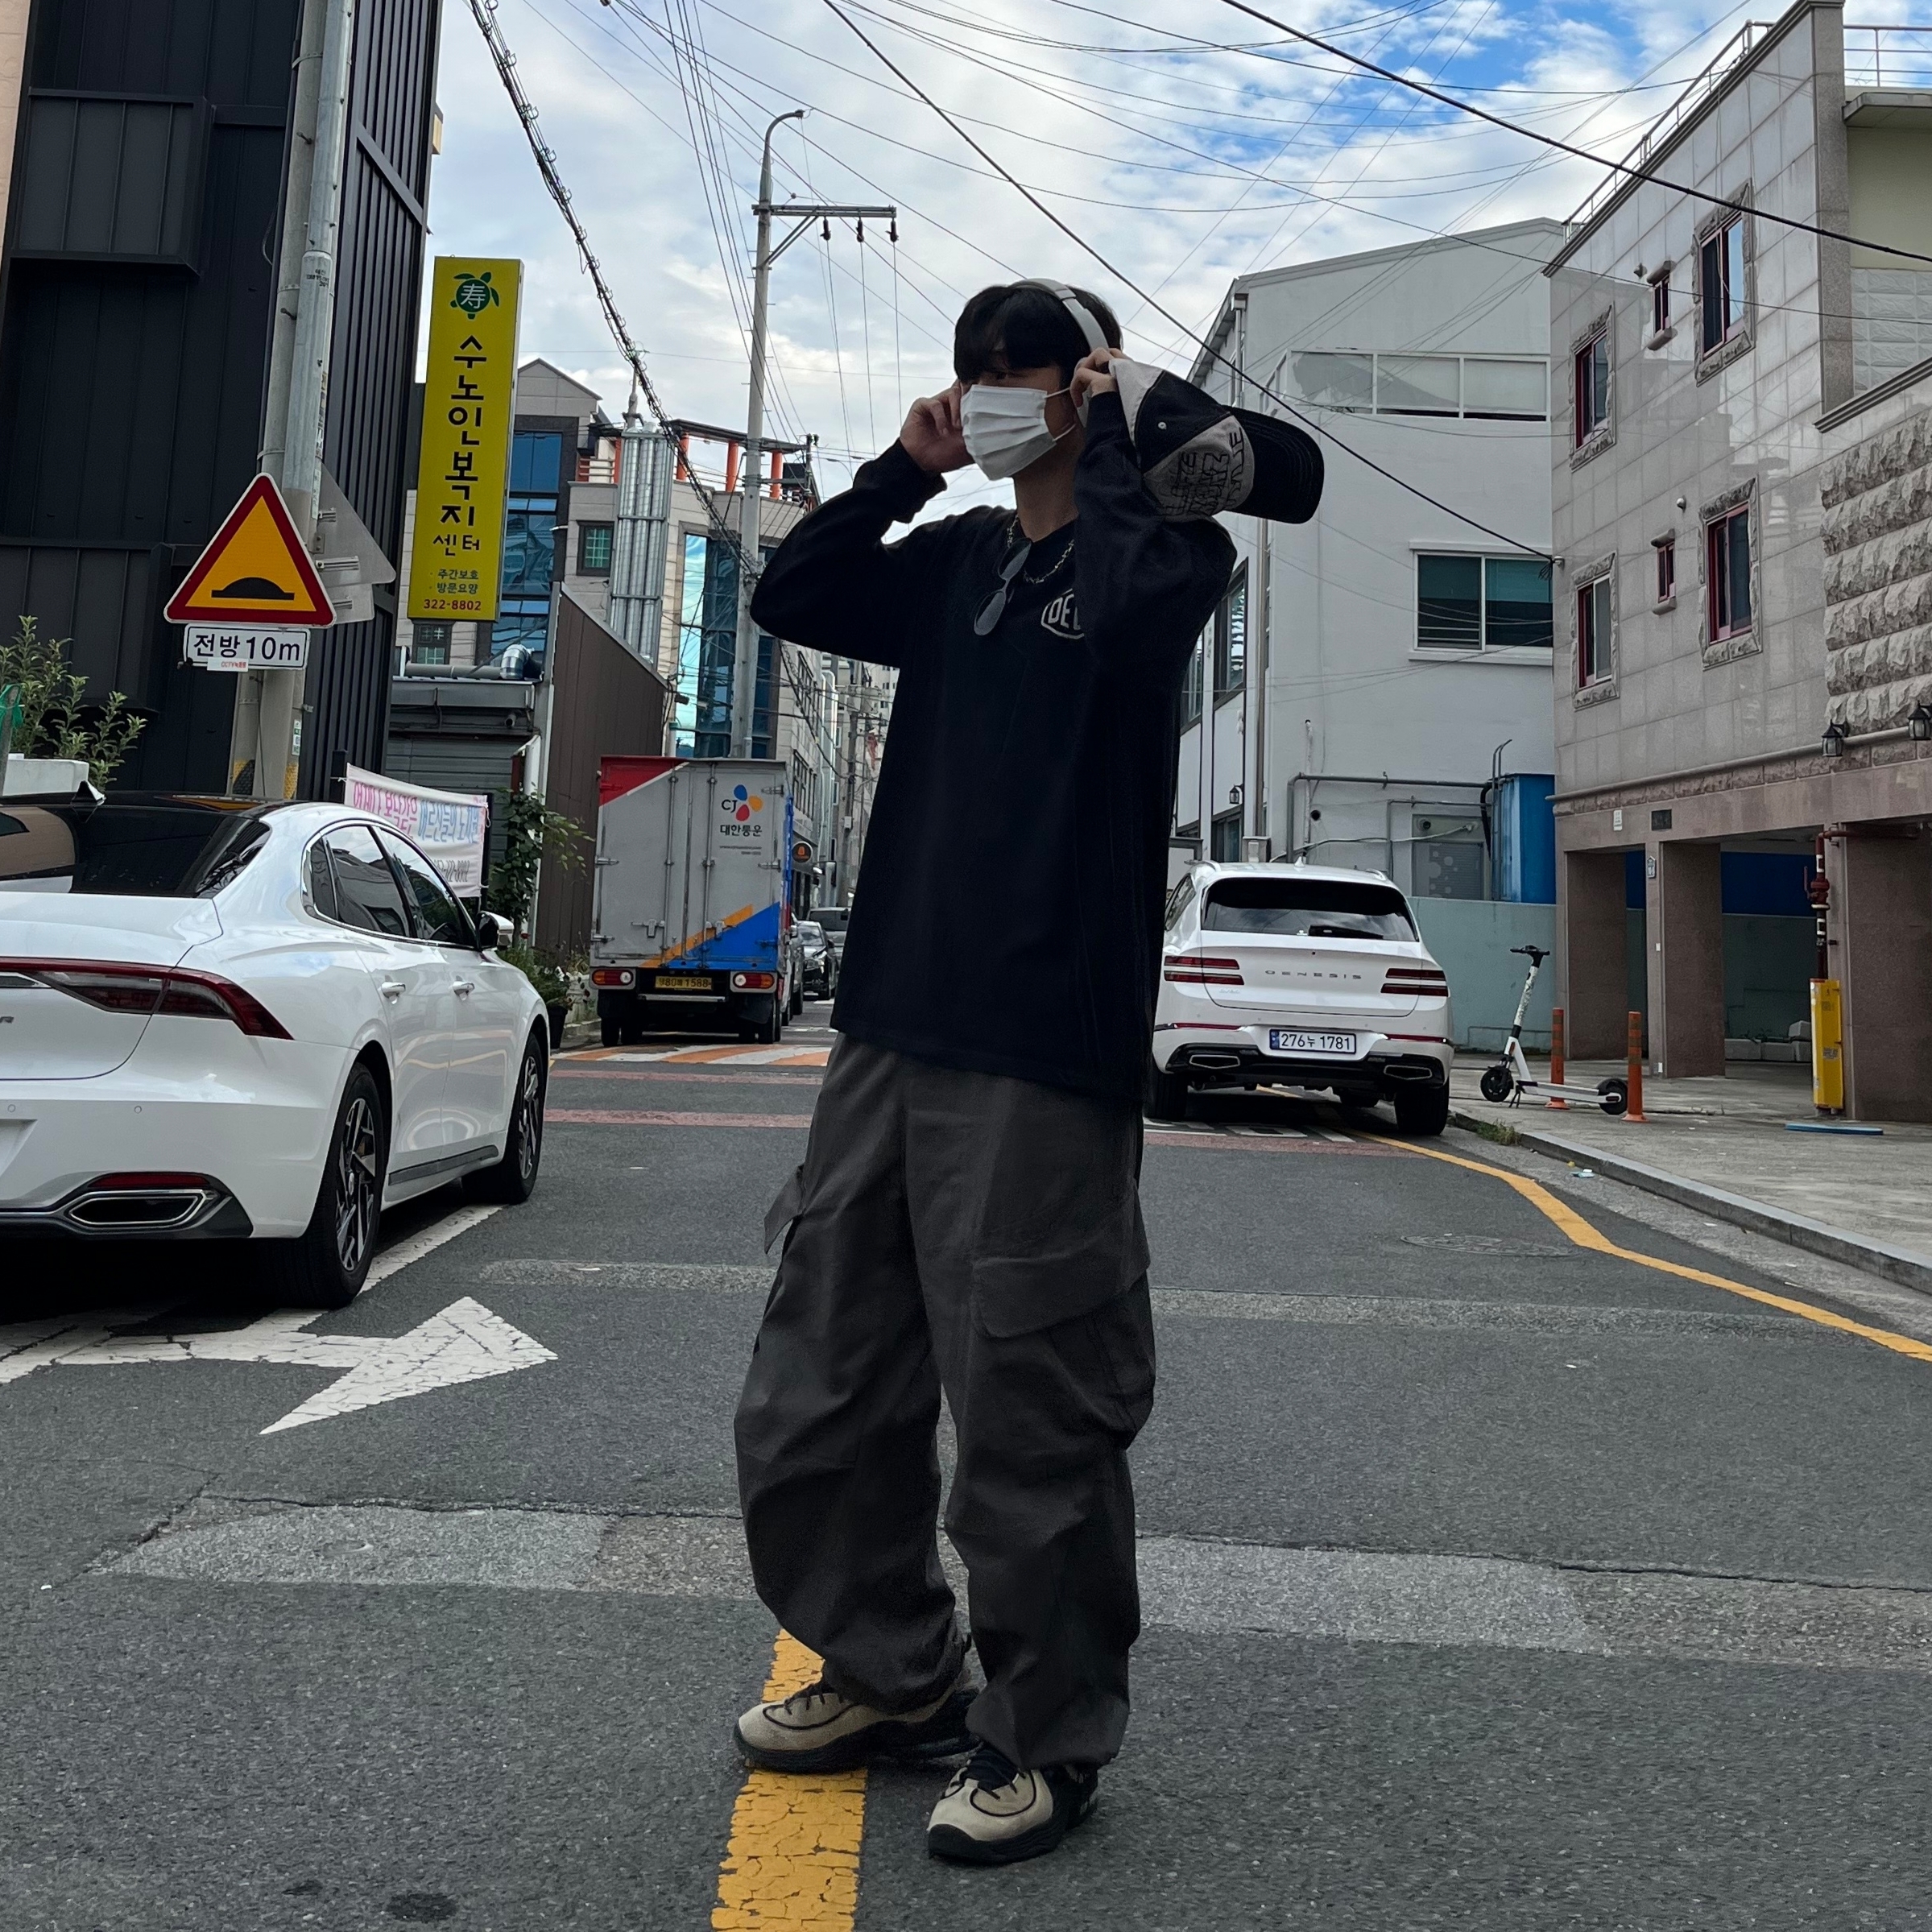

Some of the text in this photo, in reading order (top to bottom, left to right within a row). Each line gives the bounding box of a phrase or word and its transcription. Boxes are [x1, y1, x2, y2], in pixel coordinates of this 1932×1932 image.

[437, 569, 479, 580] 주간보호
[436, 582, 478, 594] 방문요양
[423, 598, 482, 611] 322-8802
[721, 799, 738, 813] CJ
[720, 825, 763, 837] 대한통운
[1265, 970, 1362, 979] GENESIS
